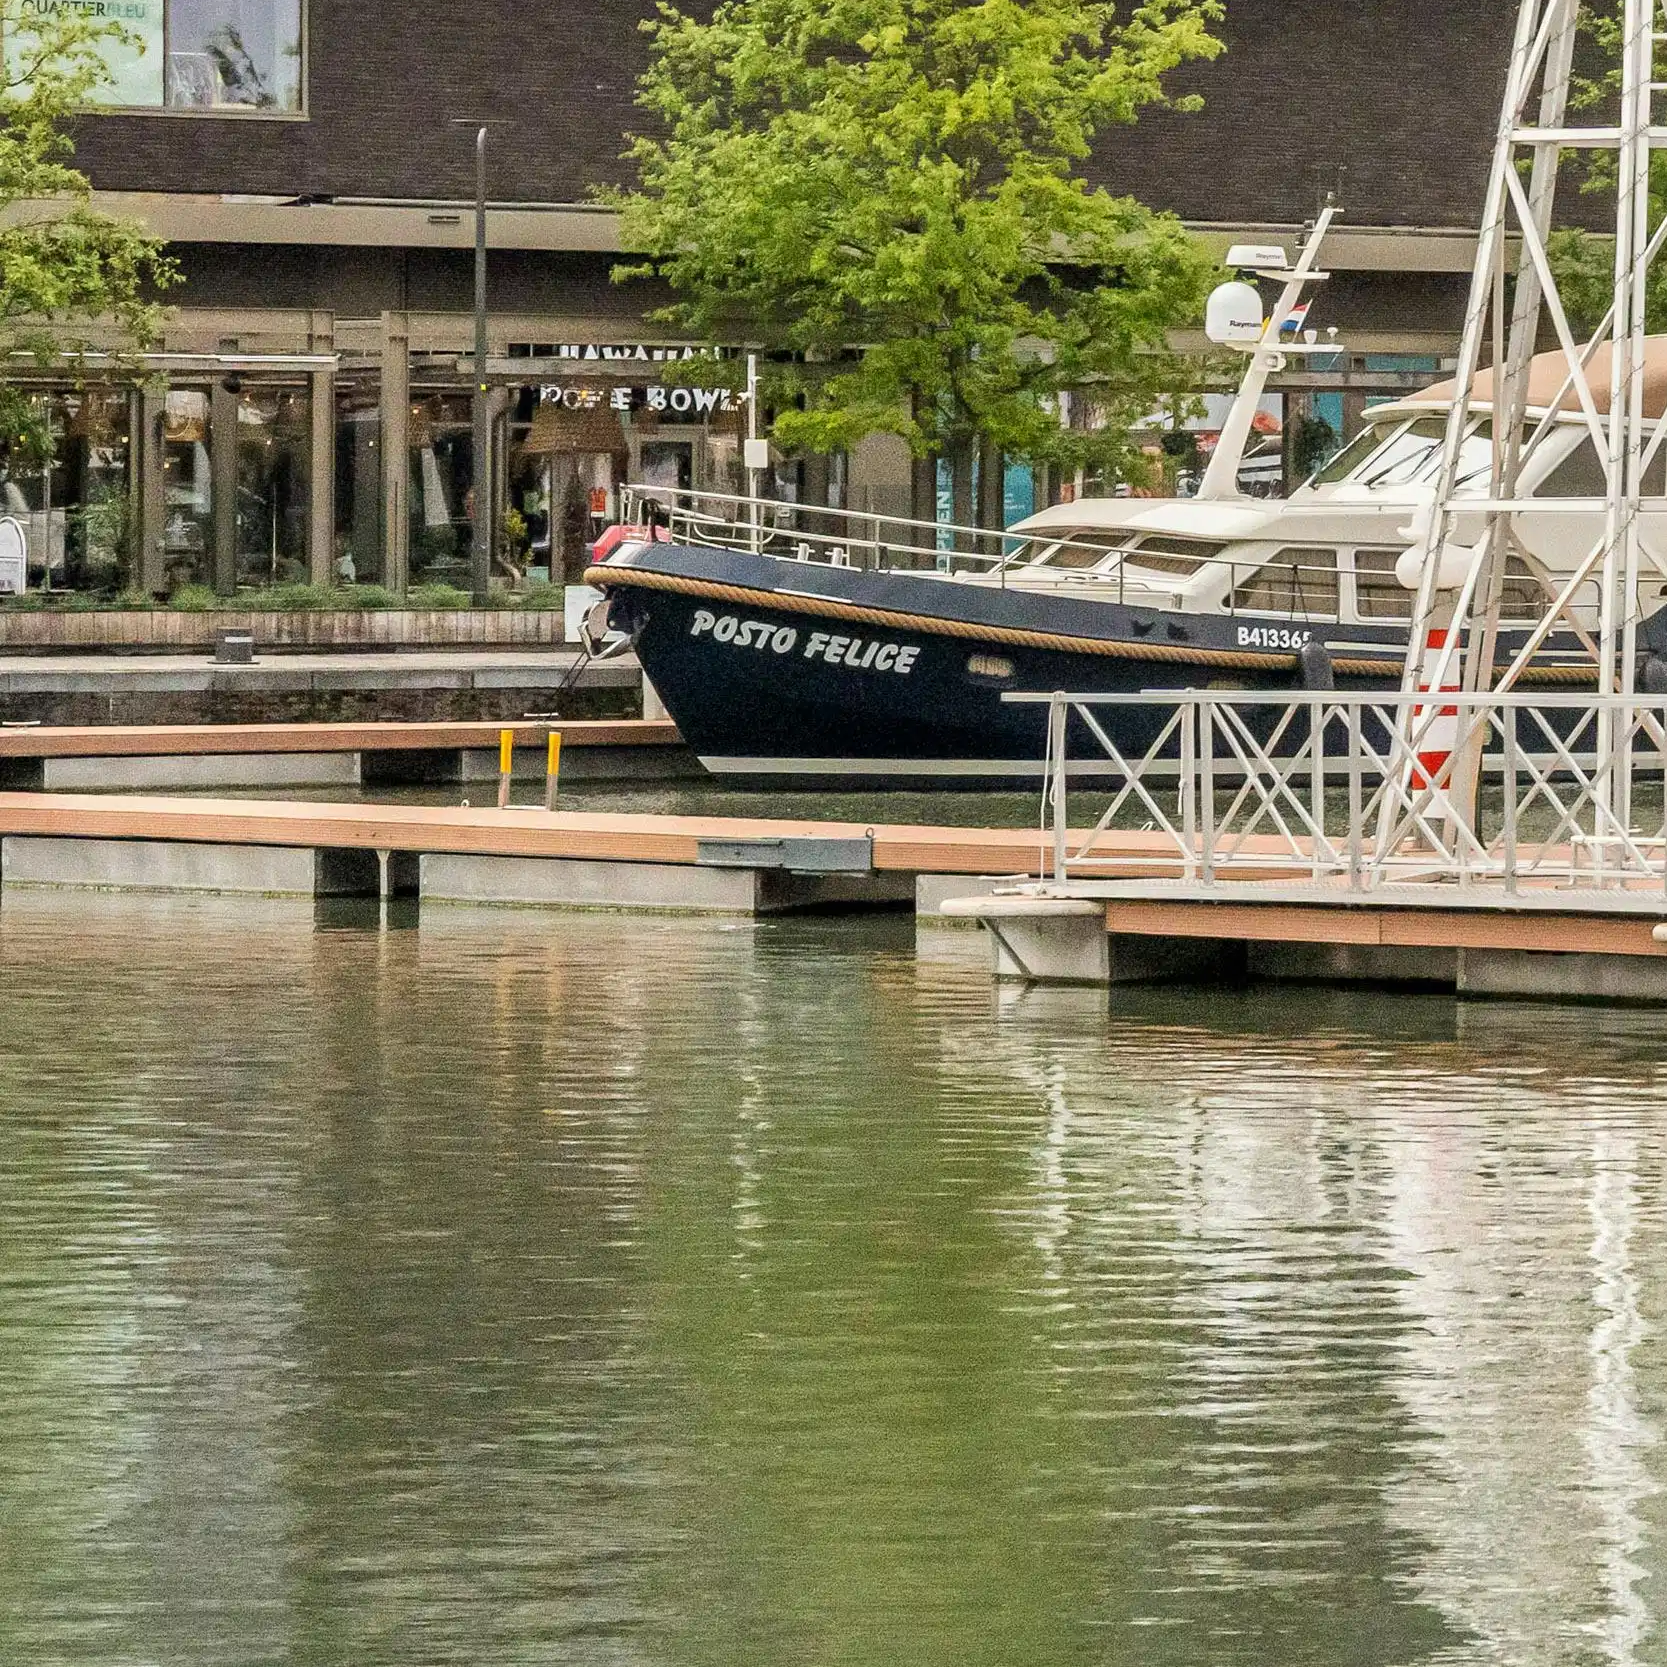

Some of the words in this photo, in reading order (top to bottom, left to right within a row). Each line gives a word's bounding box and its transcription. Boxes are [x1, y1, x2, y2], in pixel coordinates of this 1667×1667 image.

[560, 344, 720, 360] HAWAIIA
[690, 610, 797, 654] POSTO
[803, 632, 921, 674] FELICE
